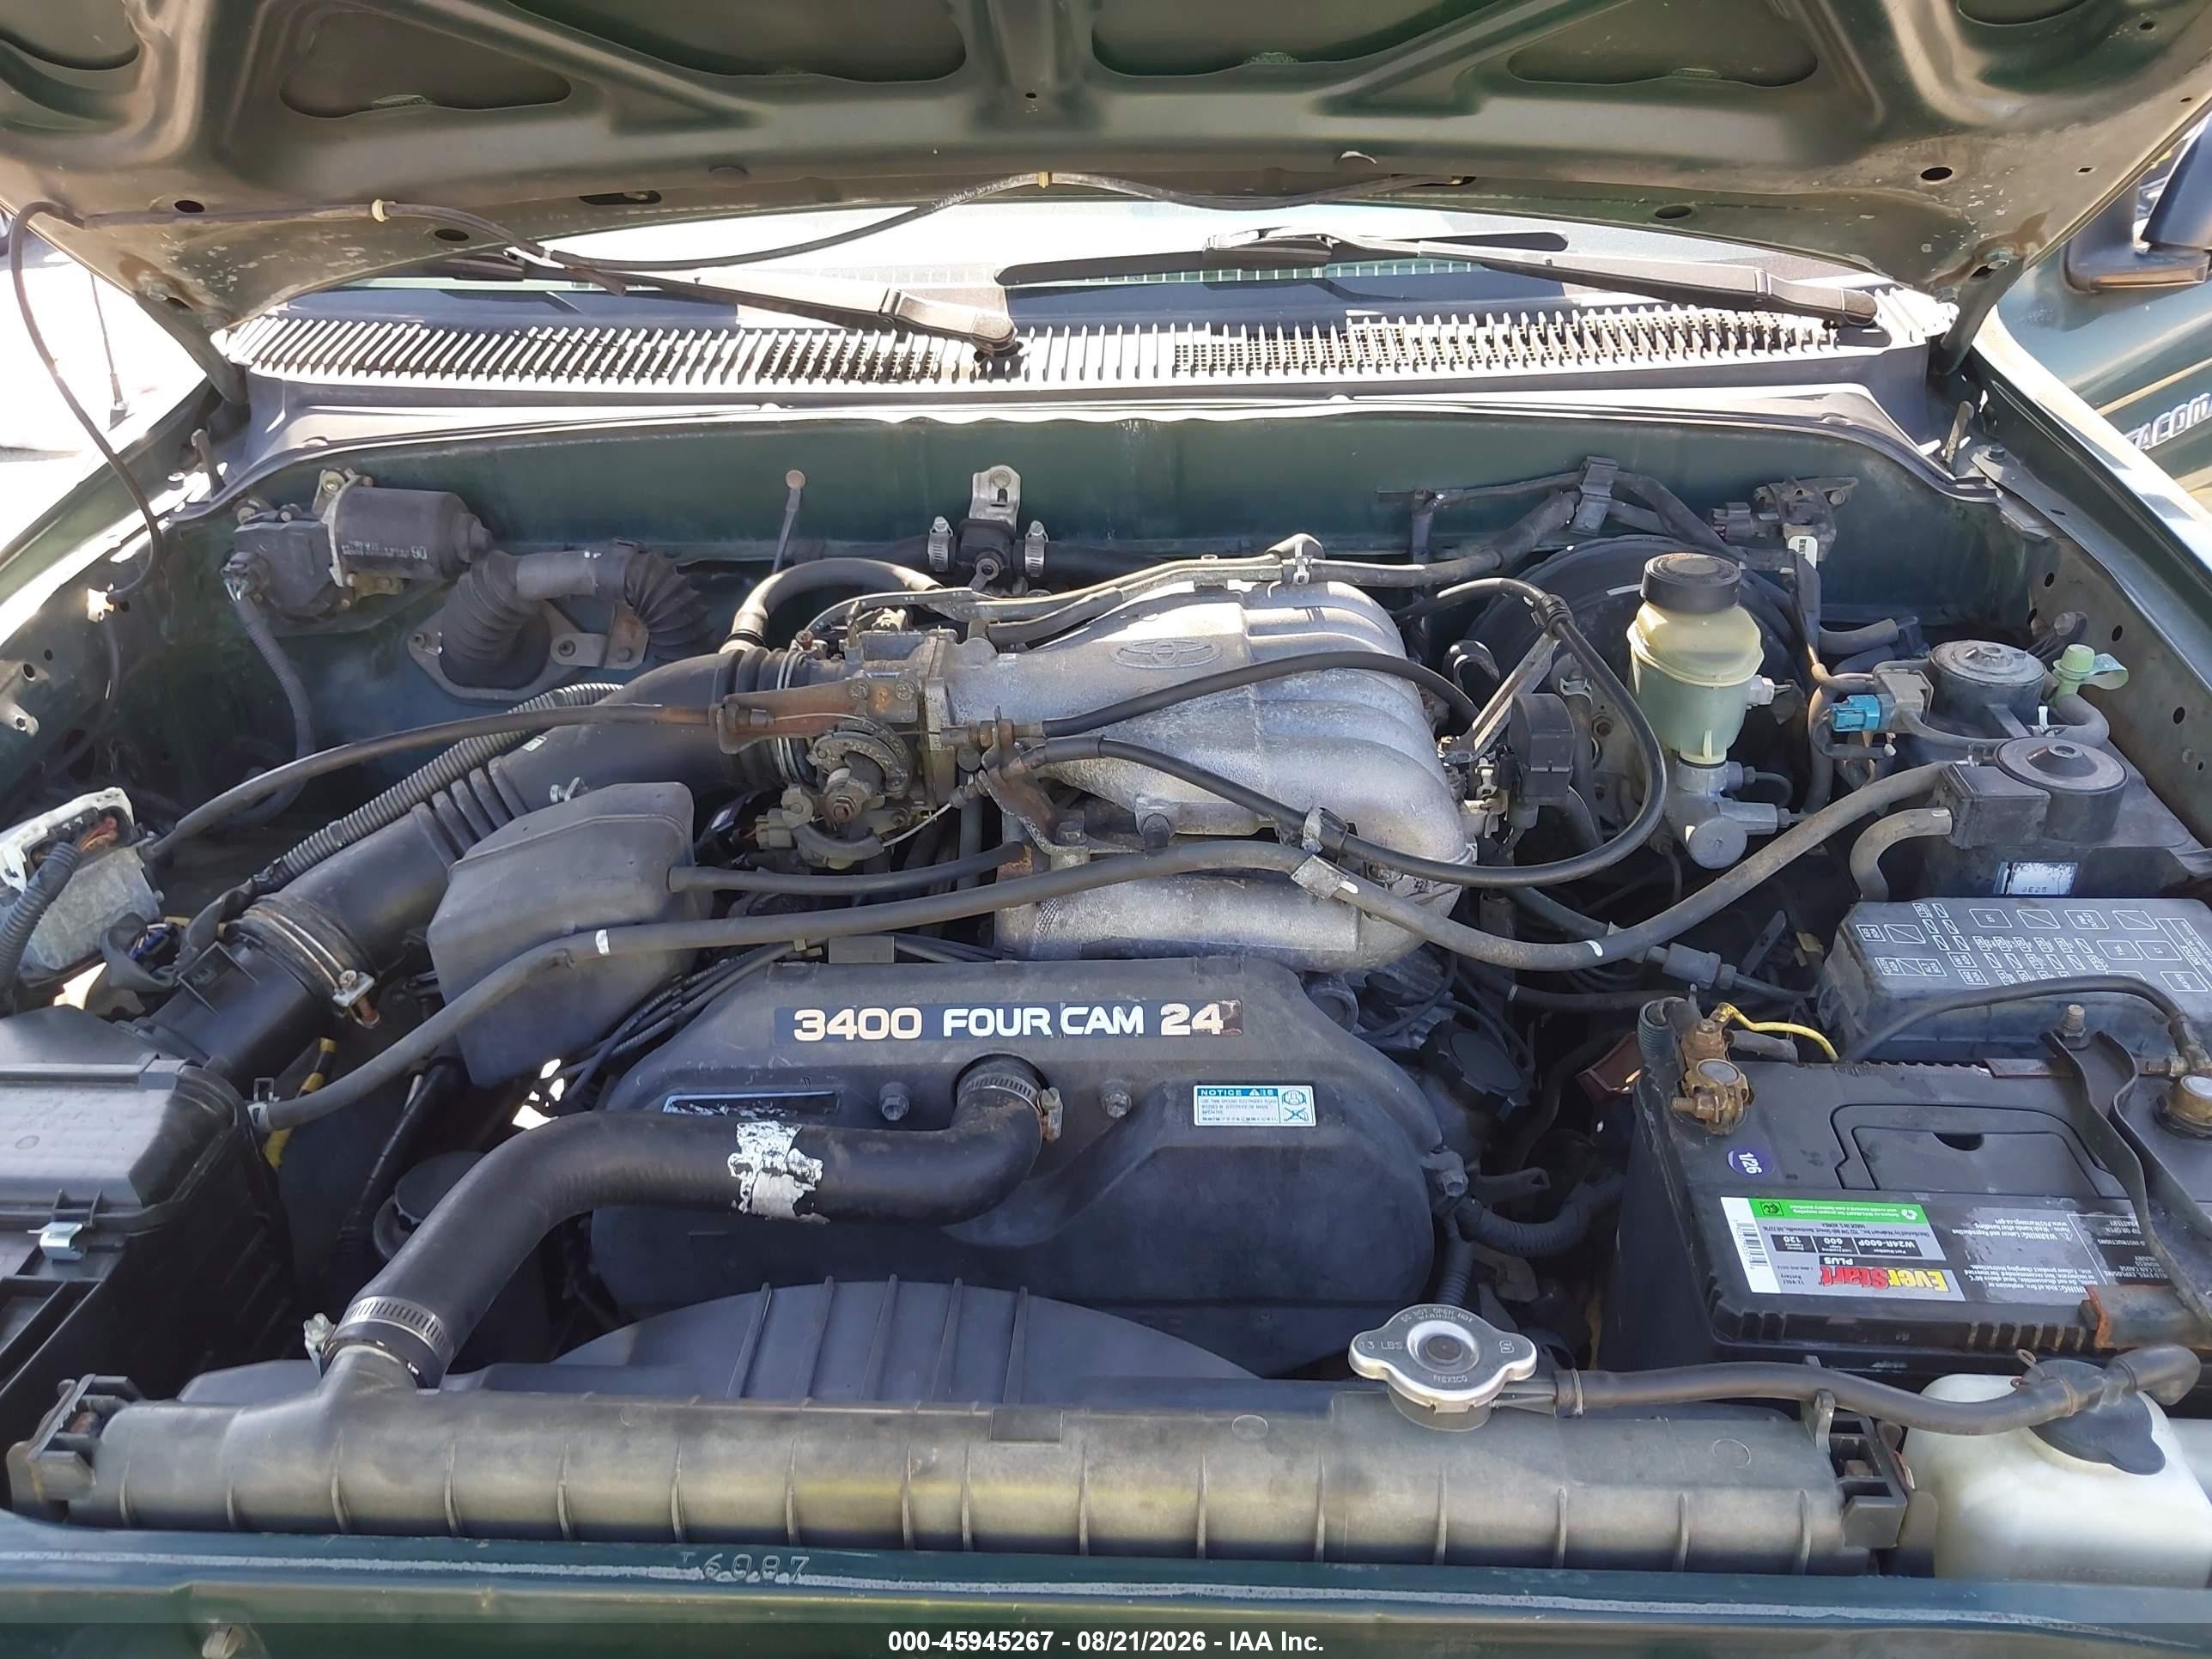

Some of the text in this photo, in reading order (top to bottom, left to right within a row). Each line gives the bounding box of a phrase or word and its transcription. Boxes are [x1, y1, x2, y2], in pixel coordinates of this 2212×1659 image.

[2122, 391, 2212, 460] TACOM
[793, 1004, 1224, 1041] 3400 FOUR CAM 24
[1739, 1152, 1762, 1174] 1/26
[1856, 1238, 1916, 1248] W24R-600P
[1822, 1256, 1855, 1265] PLUS
[1820, 1266, 1950, 1291] EverStart
